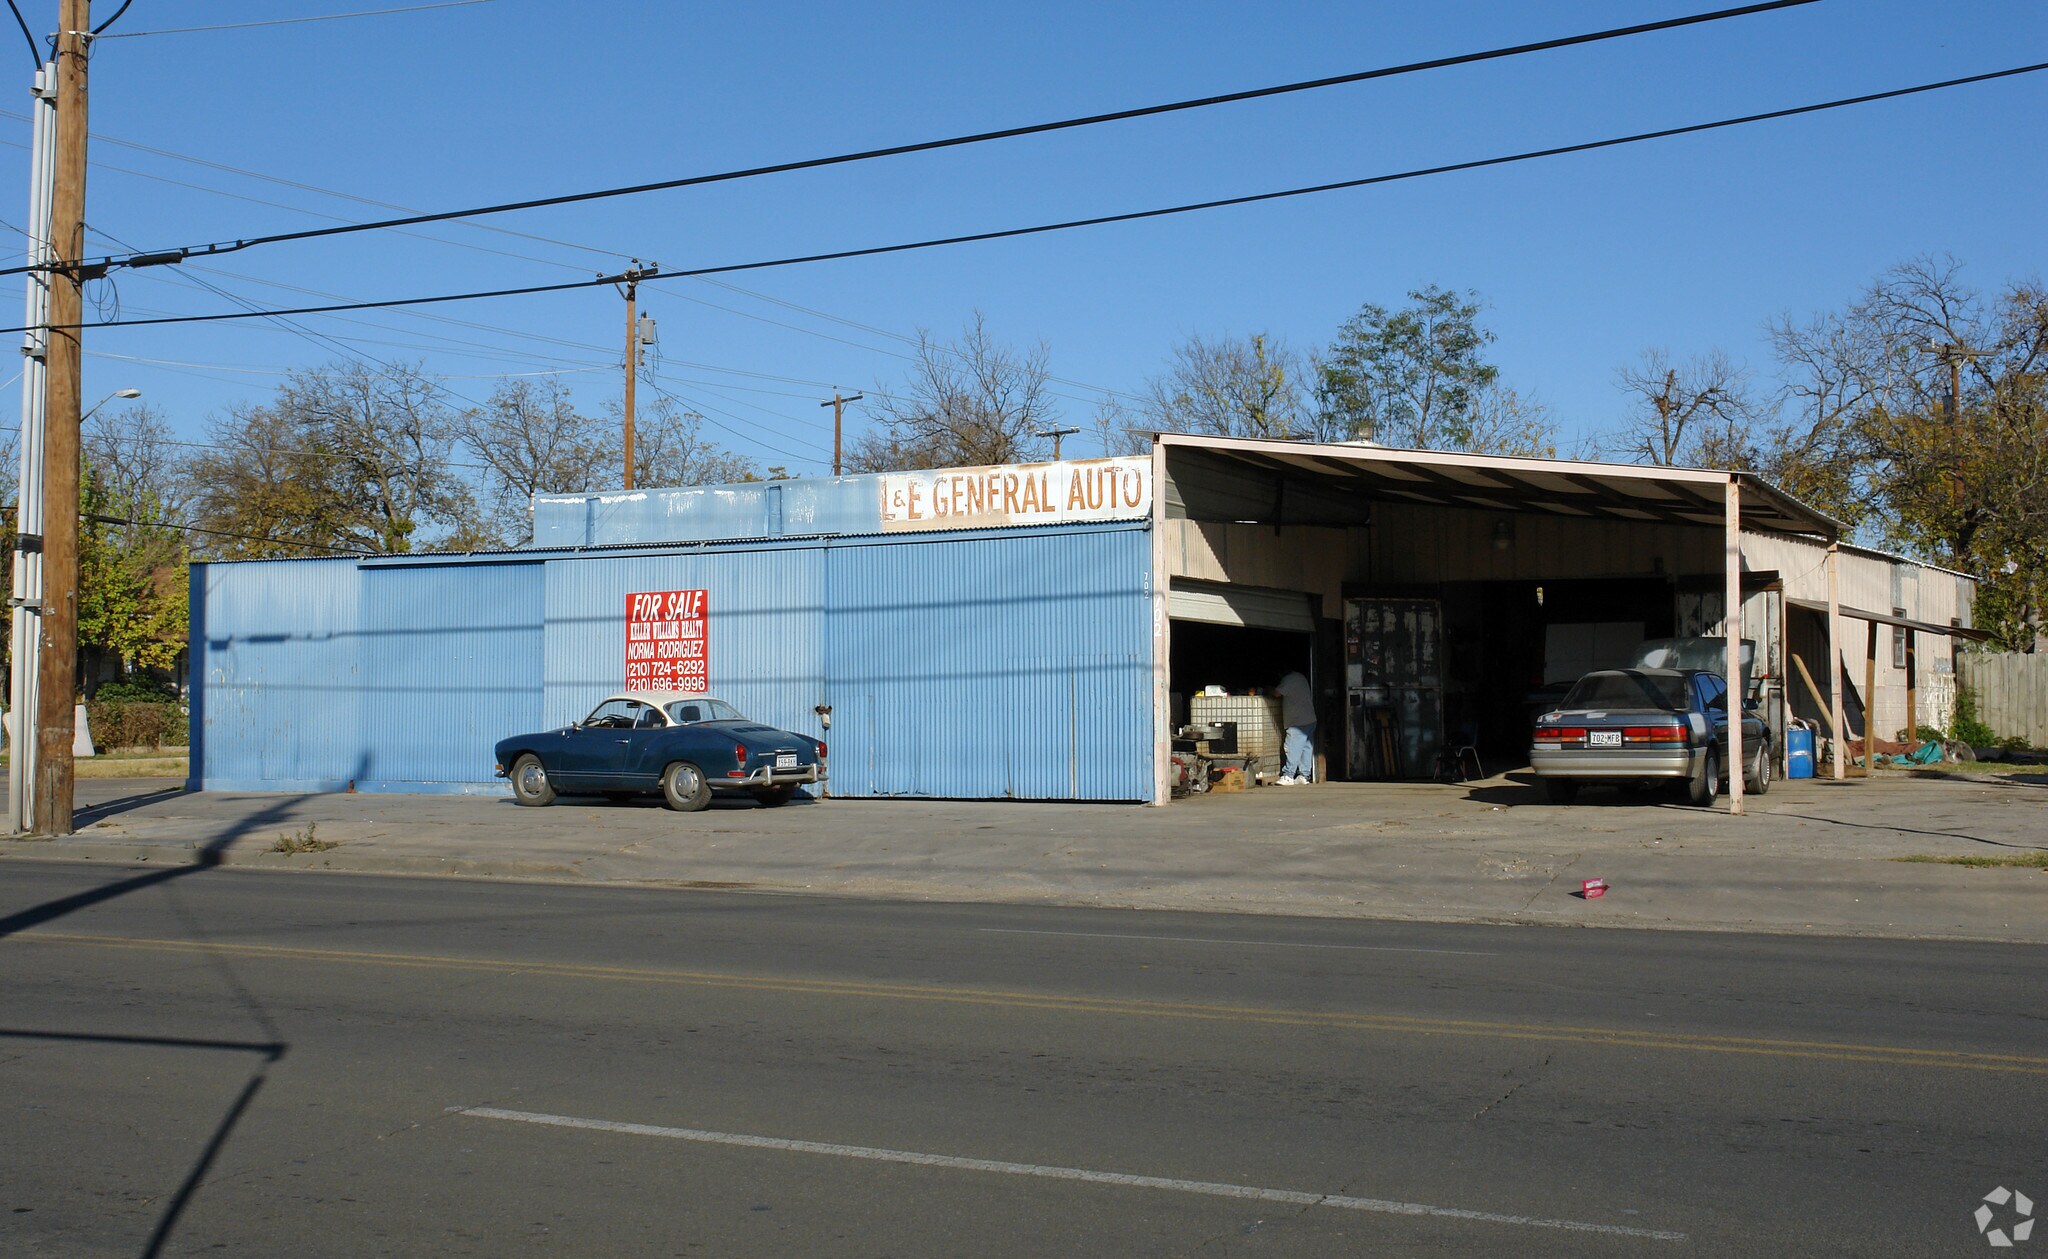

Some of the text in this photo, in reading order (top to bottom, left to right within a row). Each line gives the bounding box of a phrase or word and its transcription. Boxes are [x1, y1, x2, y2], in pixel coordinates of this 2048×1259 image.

[932, 472, 1056, 518] GENERAL
[1067, 466, 1142, 511] AUTO
[632, 591, 703, 622] FOR SALE
[630, 620, 703, 640] KELLER WILLIAMS REALTY
[627, 640, 704, 660] NORMA RODRIGUEZ
[626, 660, 705, 677] (210) 724-6292
[626, 677, 706, 692] (210) 696-9996
